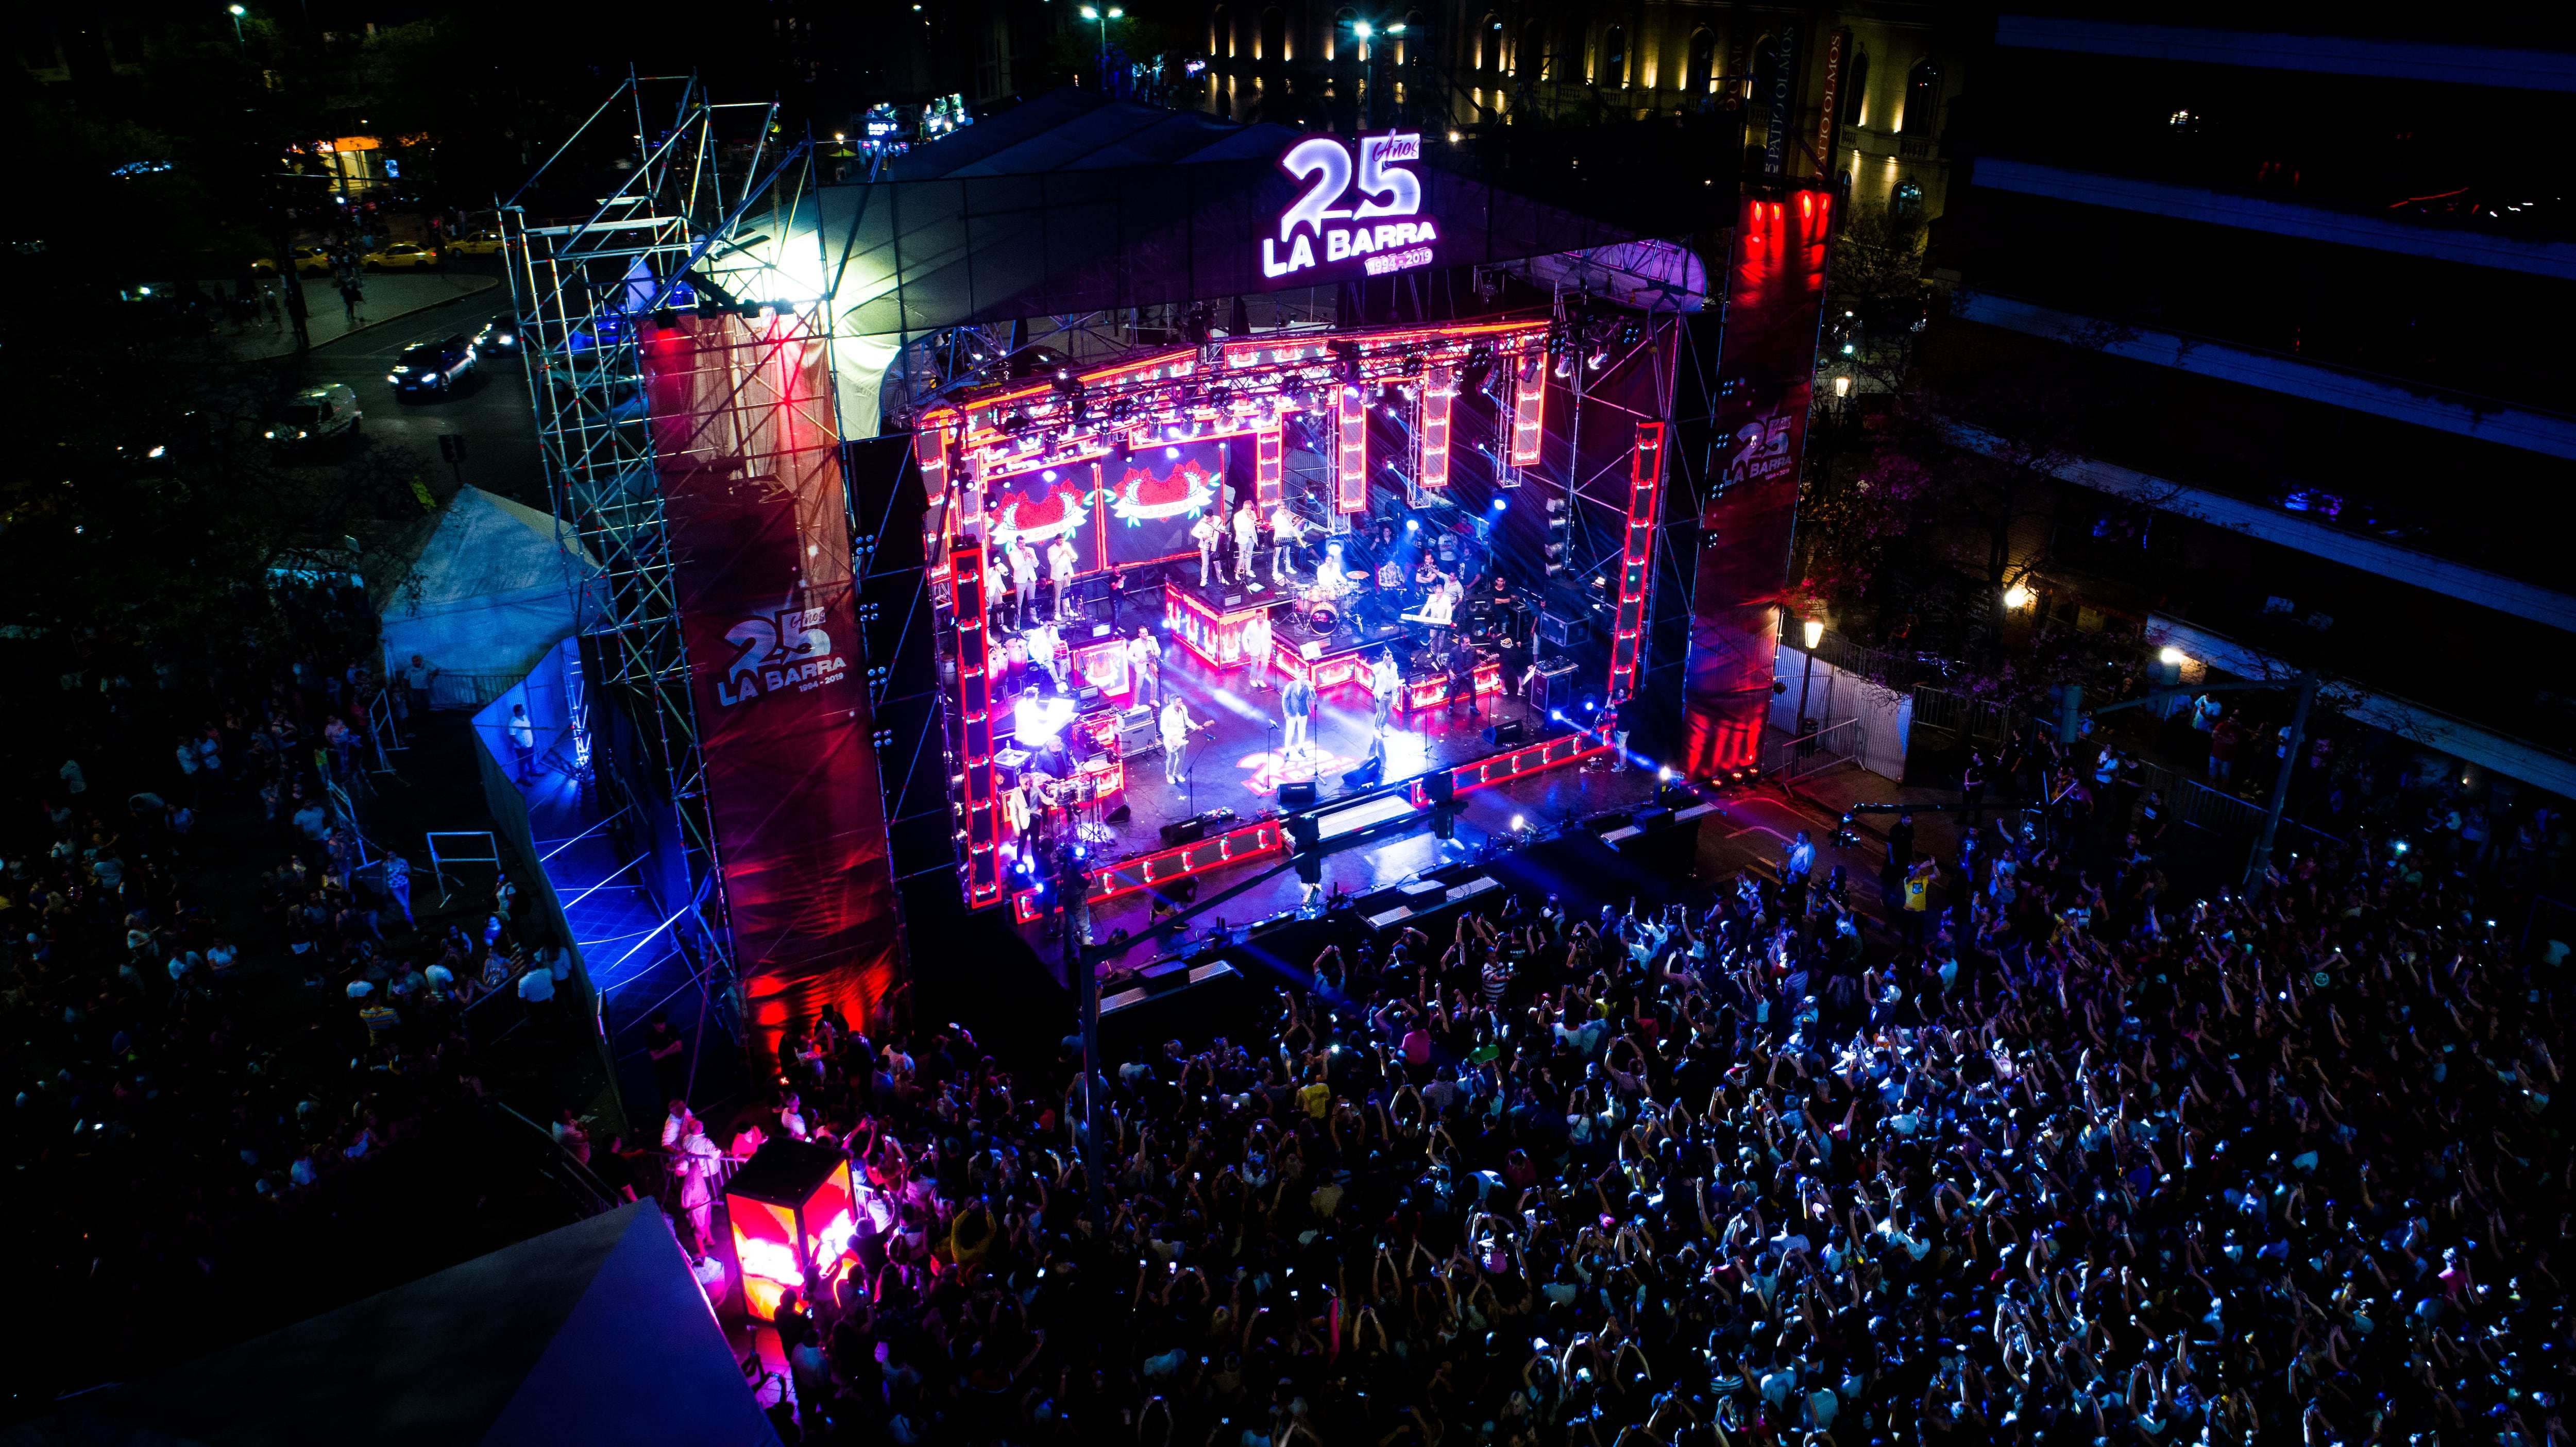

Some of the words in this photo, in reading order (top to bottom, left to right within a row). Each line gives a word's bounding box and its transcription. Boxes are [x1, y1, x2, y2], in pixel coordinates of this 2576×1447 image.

[1775, 26, 1794, 98] OLMOS
[1823, 36, 1840, 113] OLMOS
[1372, 128, 1420, 168] Años
[1281, 132, 1421, 243] 25
[1263, 233, 1316, 278] LA
[1327, 221, 1437, 262] BARRA
[1369, 258, 1397, 273] 1994
[1405, 250, 1432, 265] 2019
[1723, 466, 1744, 487] LA
[1749, 455, 1792, 479] BARRA
[1732, 416, 1791, 471] 25
[724, 606, 831, 685] 25
[718, 677, 759, 707] LA
[765, 657, 846, 692] BARRA
[799, 680, 819, 692] 1994
[824, 672, 844, 684] 2019
